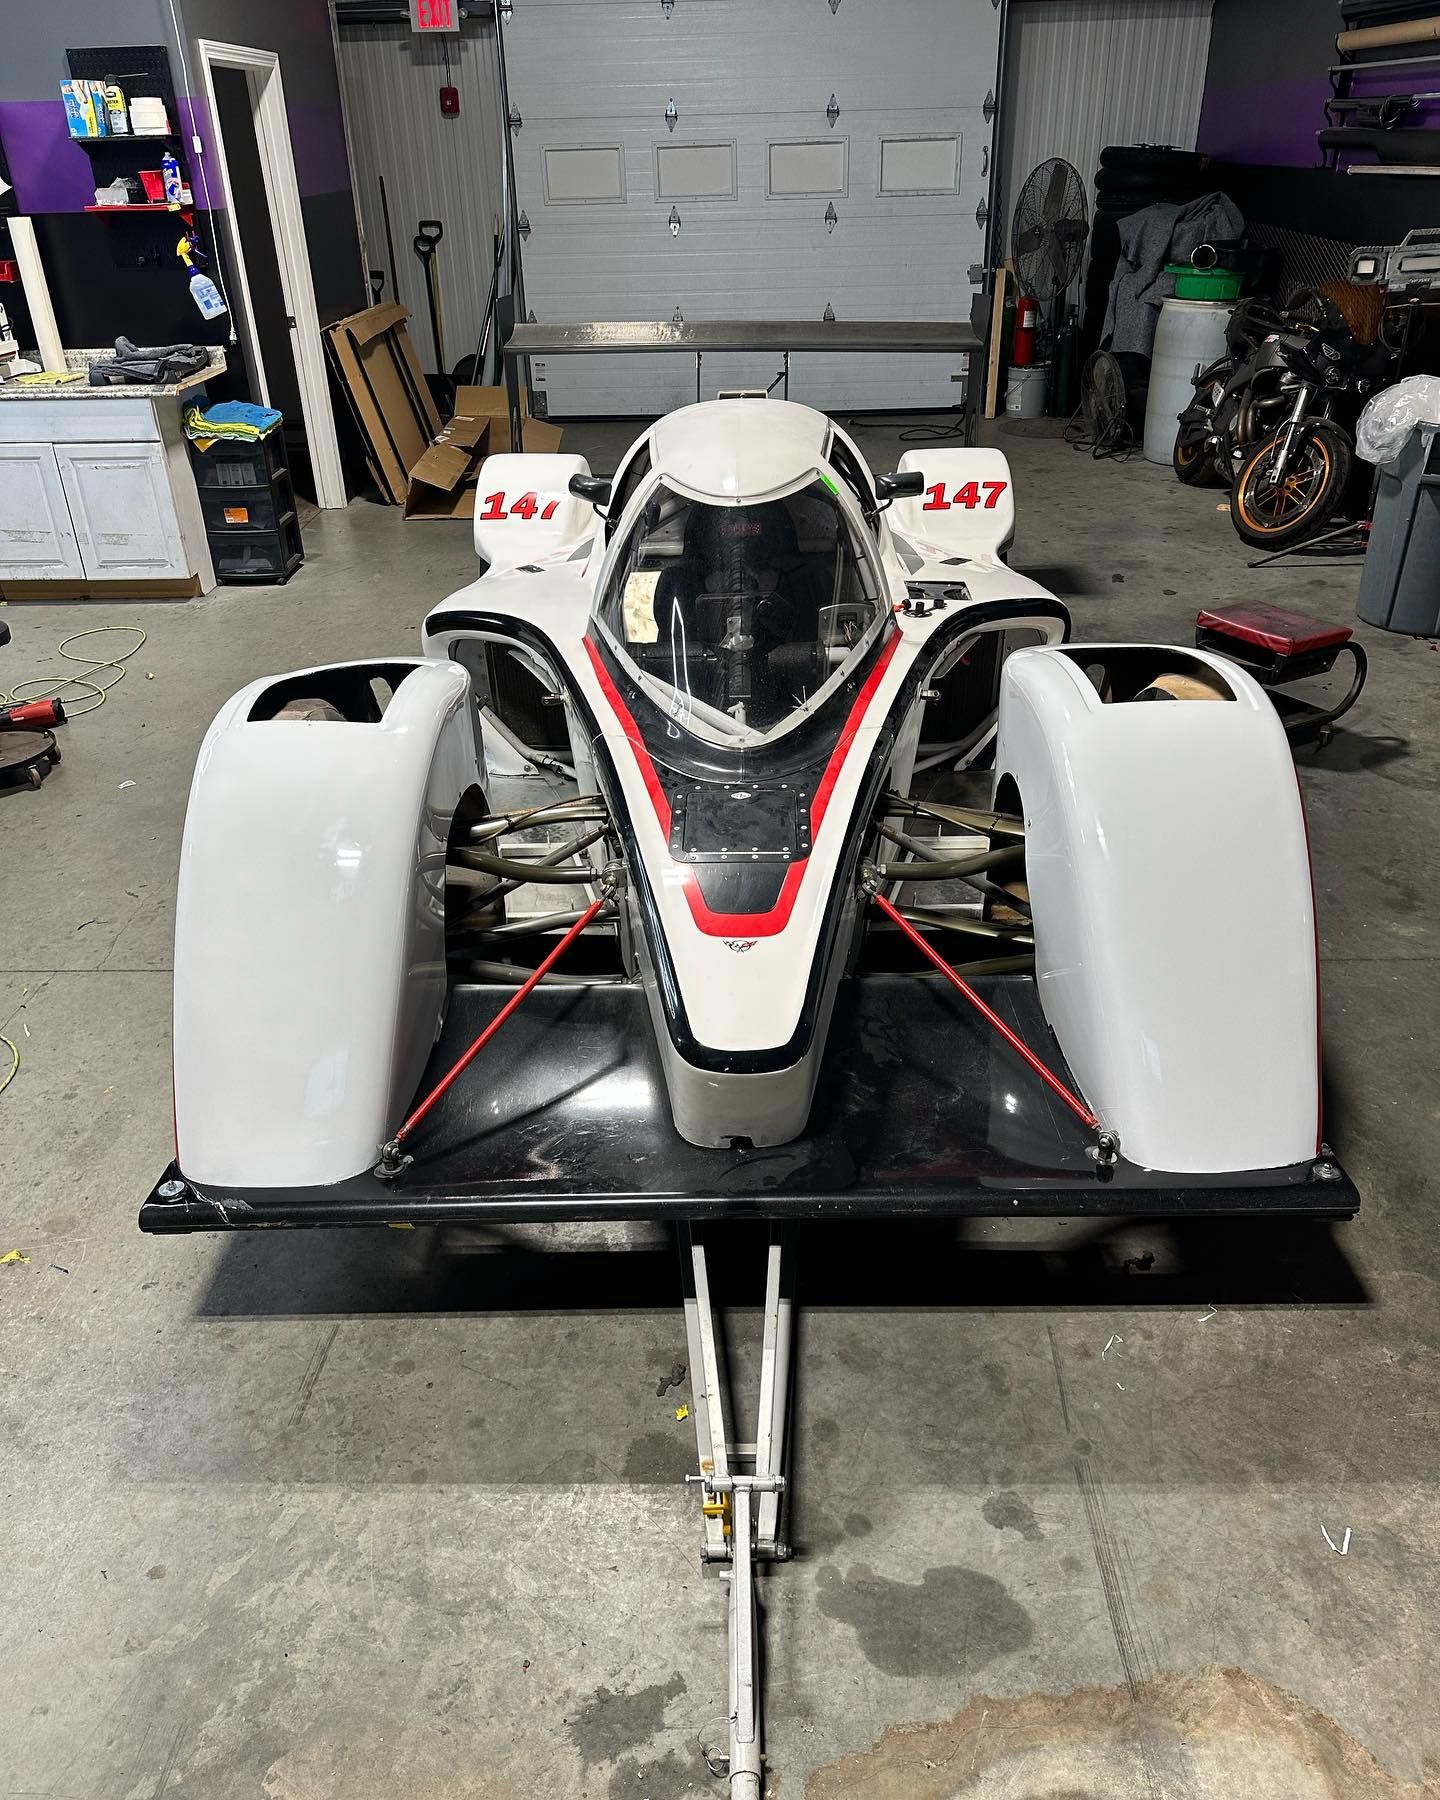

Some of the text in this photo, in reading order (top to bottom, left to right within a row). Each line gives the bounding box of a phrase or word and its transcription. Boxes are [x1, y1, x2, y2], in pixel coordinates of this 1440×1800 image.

[417, 0, 452, 28] EXIT
[480, 492, 562, 520] 147
[923, 482, 1007, 510] 147
